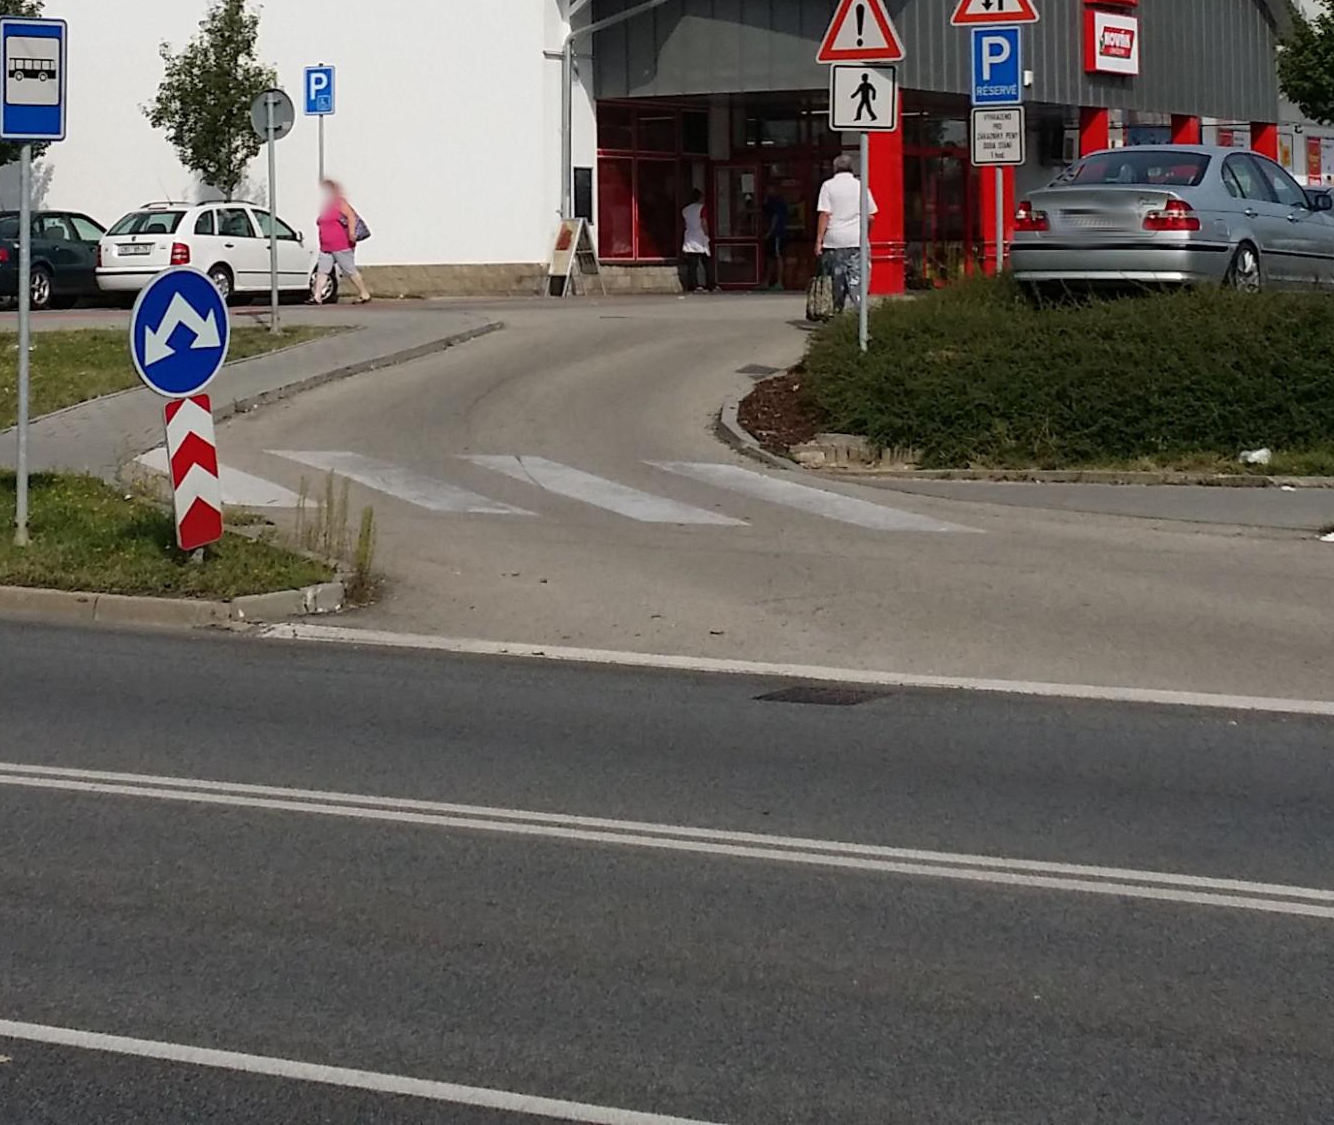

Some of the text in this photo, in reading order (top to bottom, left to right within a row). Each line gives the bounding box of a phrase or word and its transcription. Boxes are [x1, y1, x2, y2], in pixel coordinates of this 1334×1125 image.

[982, 36, 1011, 81] P
[310, 72, 328, 101] P
[976, 83, 1017, 96] RÉSERVÉ
